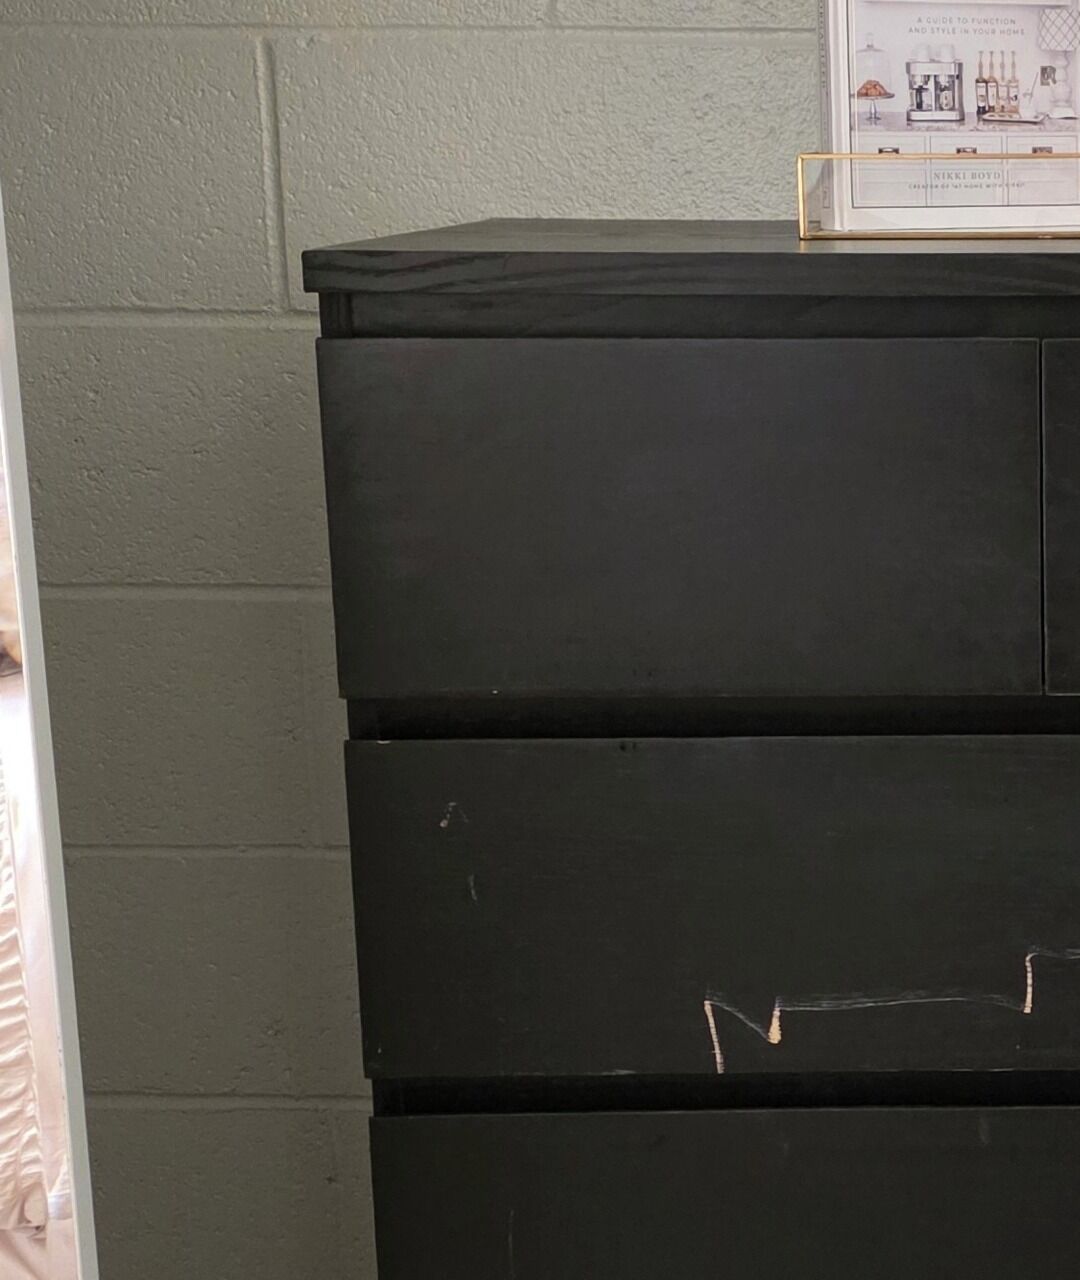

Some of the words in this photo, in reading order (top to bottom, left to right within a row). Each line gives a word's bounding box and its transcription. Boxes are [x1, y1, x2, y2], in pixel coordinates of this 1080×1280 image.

[916, 16, 923, 24] A
[926, 16, 953, 24] GUIDE
[957, 17, 969, 25] TO
[971, 17, 1016, 25] FUNCTION
[908, 26, 928, 35] AND
[930, 26, 956, 35] STYLE
[960, 27, 969, 35] IN
[972, 27, 996, 36] YOUR
[999, 27, 1025, 36] HOME
[933, 171, 966, 181] NIKKI
[971, 171, 1001, 180] BOYD
